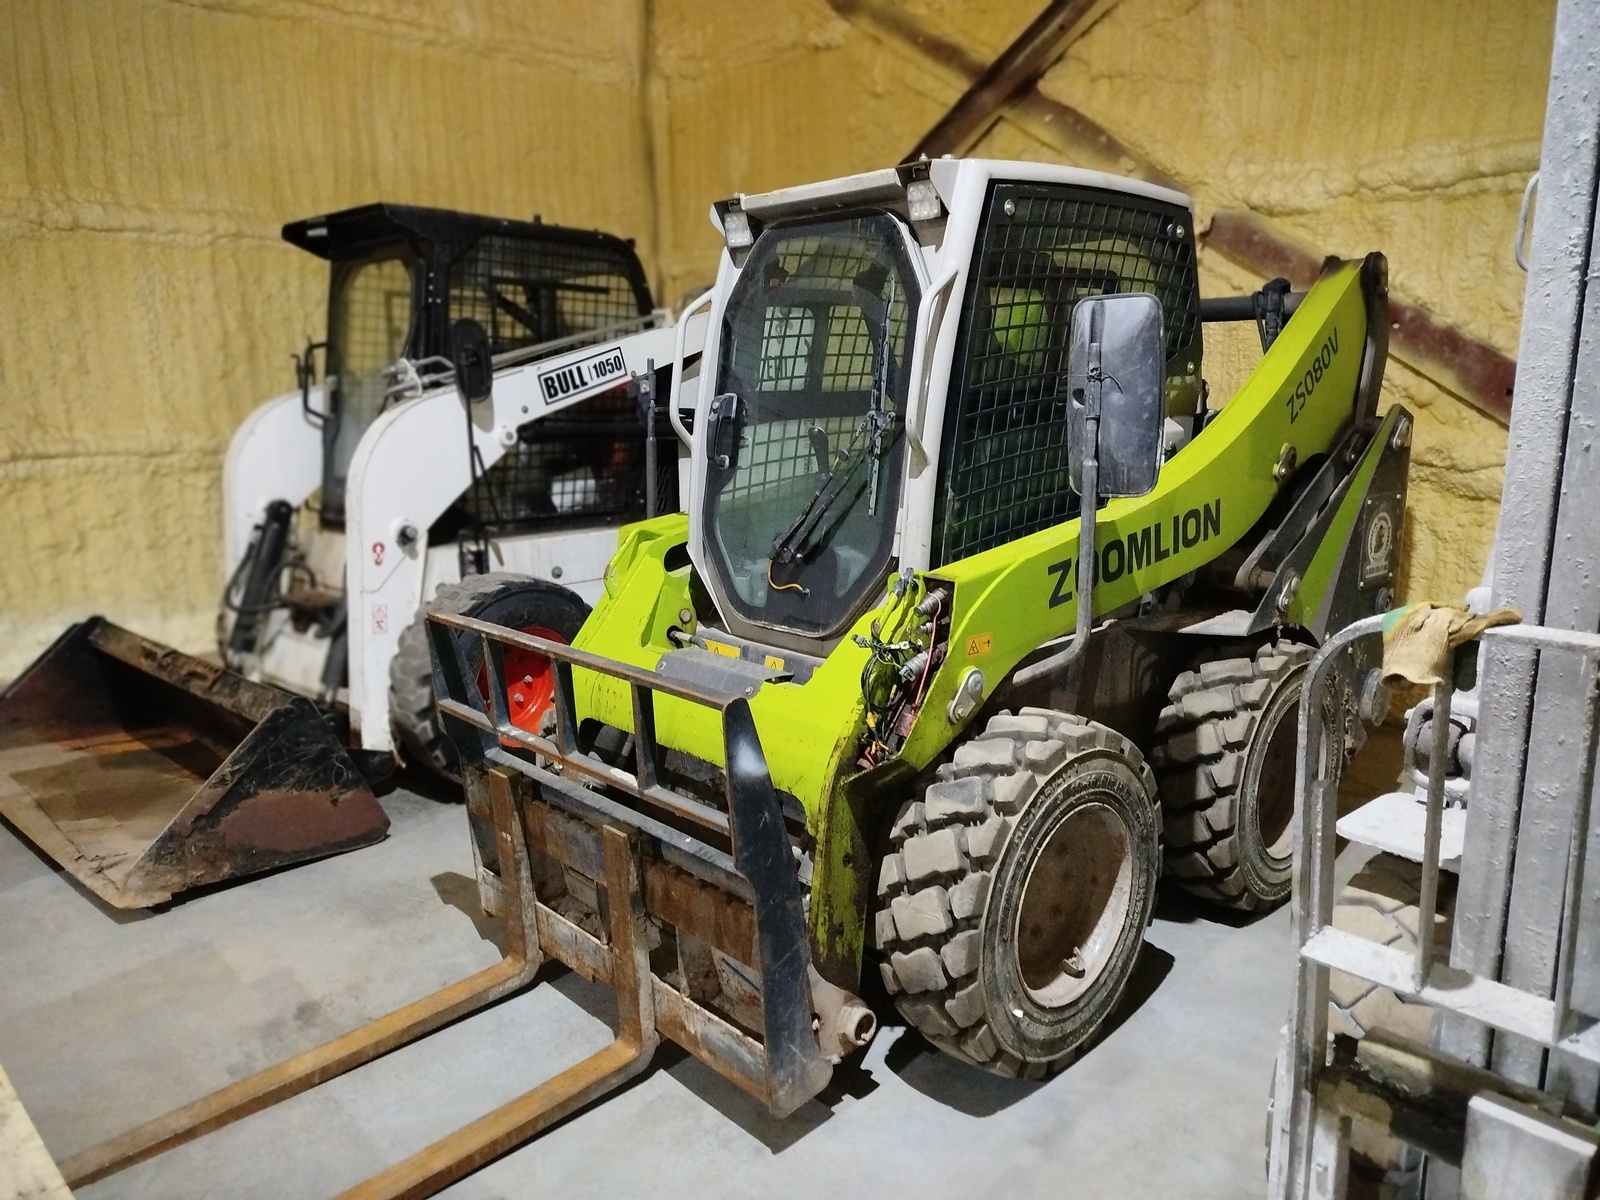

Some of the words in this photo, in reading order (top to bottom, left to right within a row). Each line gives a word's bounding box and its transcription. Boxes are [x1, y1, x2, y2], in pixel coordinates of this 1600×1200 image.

[543, 365, 588, 399] BULL
[592, 355, 622, 379] 1050
[1286, 326, 1339, 425] ZS080V
[1047, 499, 1221, 609] ZOOMLION
